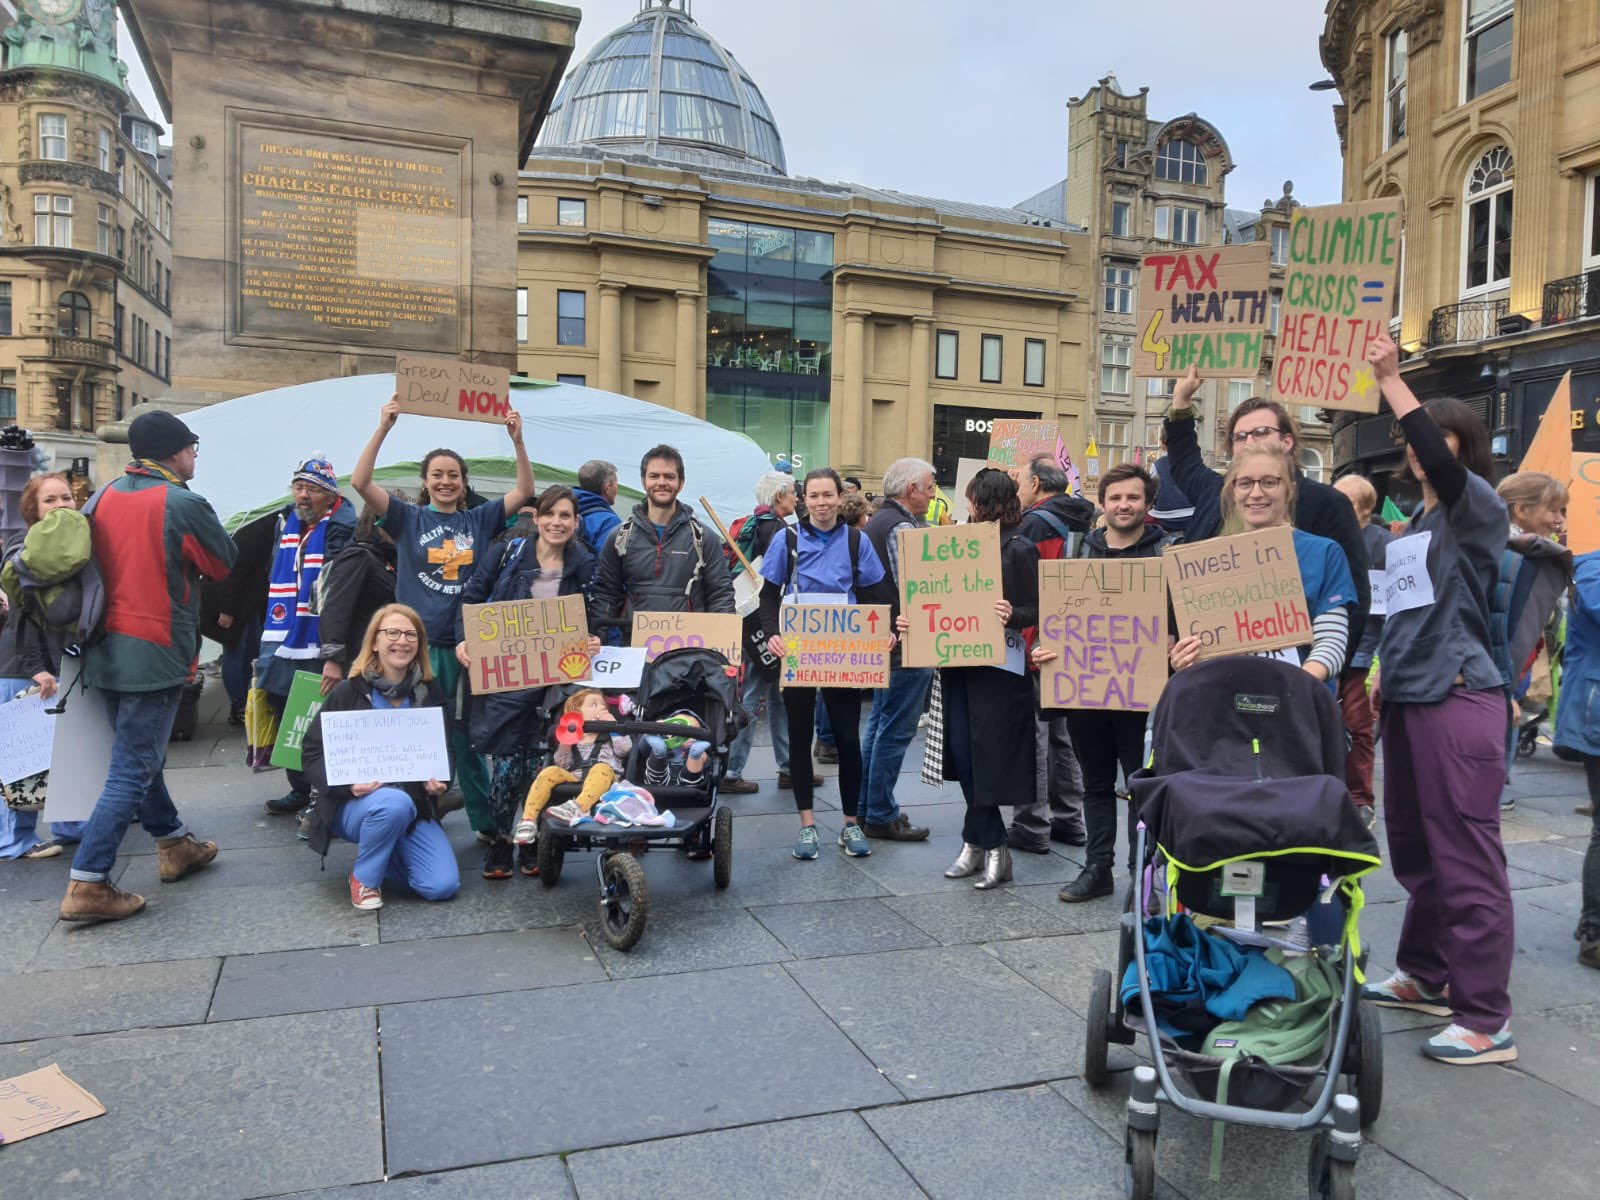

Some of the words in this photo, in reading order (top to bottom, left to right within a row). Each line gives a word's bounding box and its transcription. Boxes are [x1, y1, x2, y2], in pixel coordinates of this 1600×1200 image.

[331, 152, 352, 162] WAS
[405, 161, 416, 171] IN
[329, 183, 375, 199] EARL
[379, 189, 424, 206] GREY
[1290, 211, 1398, 266] CLIMATE
[1144, 253, 1221, 292] TAX
[262, 290, 290, 299] AFTER
[1286, 272, 1358, 316] CRISIS
[268, 300, 303, 310] SAFELY
[305, 303, 324, 312] AND
[392, 311, 434, 322] ACHIEVED
[313, 315, 323, 323] IN
[326, 316, 342, 325] THE
[345, 317, 369, 326] YEAR
[1141, 309, 1170, 371] 4
[1170, 332, 1262, 370] HEALTH
[1281, 313, 1381, 361] HEALTH
[397, 358, 451, 380] Green
[459, 367, 498, 386] New
[1277, 355, 1350, 401] CRISIS
[408, 381, 450, 406] Deal
[458, 388, 513, 418] NOW
[921, 533, 980, 562] Let's
[1174, 544, 1240, 580] Invest
[1254, 541, 1282, 565] in
[443, 585, 463, 594] NEW
[906, 573, 953, 604] paint
[963, 569, 994, 592] the
[1042, 562, 1163, 593] HEALTH
[1181, 568, 1301, 615] Renewables
[784, 607, 862, 633] RISING
[922, 603, 980, 632] Toon
[1058, 596, 1090, 615] for
[1101, 597, 1112, 606] a
[478, 600, 579, 641] SHELL
[637, 614, 685, 631] Don't
[1043, 614, 1159, 644] GREEN
[1190, 620, 1227, 646] for
[1234, 600, 1310, 642] Health
[501, 640, 527, 656] GO
[532, 636, 555, 652] TO
[710, 641, 740, 660] out
[800, 653, 846, 665] ENERGY
[935, 632, 994, 665] Green
[1064, 645, 1142, 674] NEW
[480, 651, 560, 690] HELL
[594, 660, 622, 674] GP
[796, 670, 836, 682] HEALTH
[1054, 672, 1149, 708] DEAL
[327, 717, 352, 729] TELL
[375, 715, 401, 728] WHAT
[328, 746, 356, 757] WHAT
[360, 743, 397, 755] IMPACTS
[402, 743, 425, 753] WILL
[328, 756, 371, 766] CLIMATE
[377, 754, 409, 763] CHANGE
[416, 752, 440, 761] HAVE
[331, 769, 349, 777] ON
